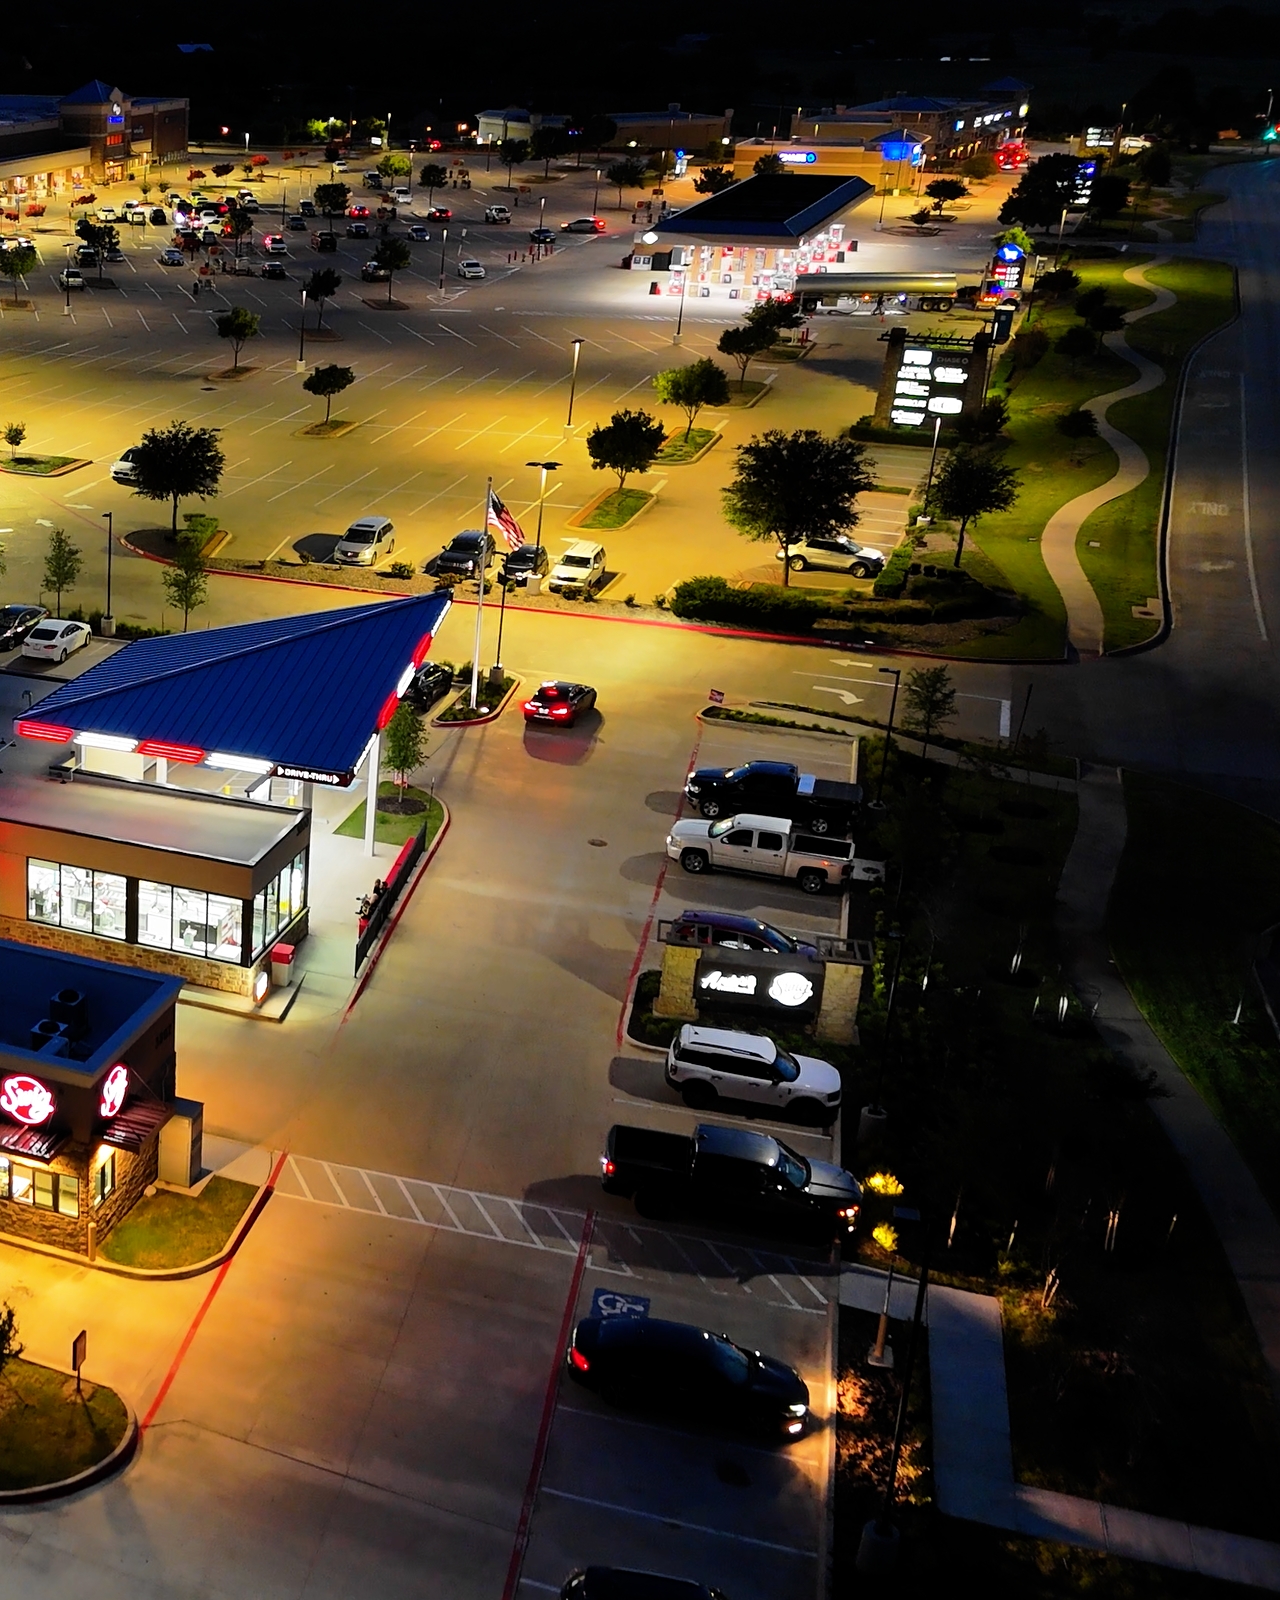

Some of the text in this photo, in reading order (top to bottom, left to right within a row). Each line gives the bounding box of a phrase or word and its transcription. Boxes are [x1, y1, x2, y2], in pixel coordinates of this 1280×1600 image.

[936, 356, 961, 364] CHASE
[1188, 502, 1228, 516] ONLY
[284, 768, 333, 783] DRIVE-THRU
